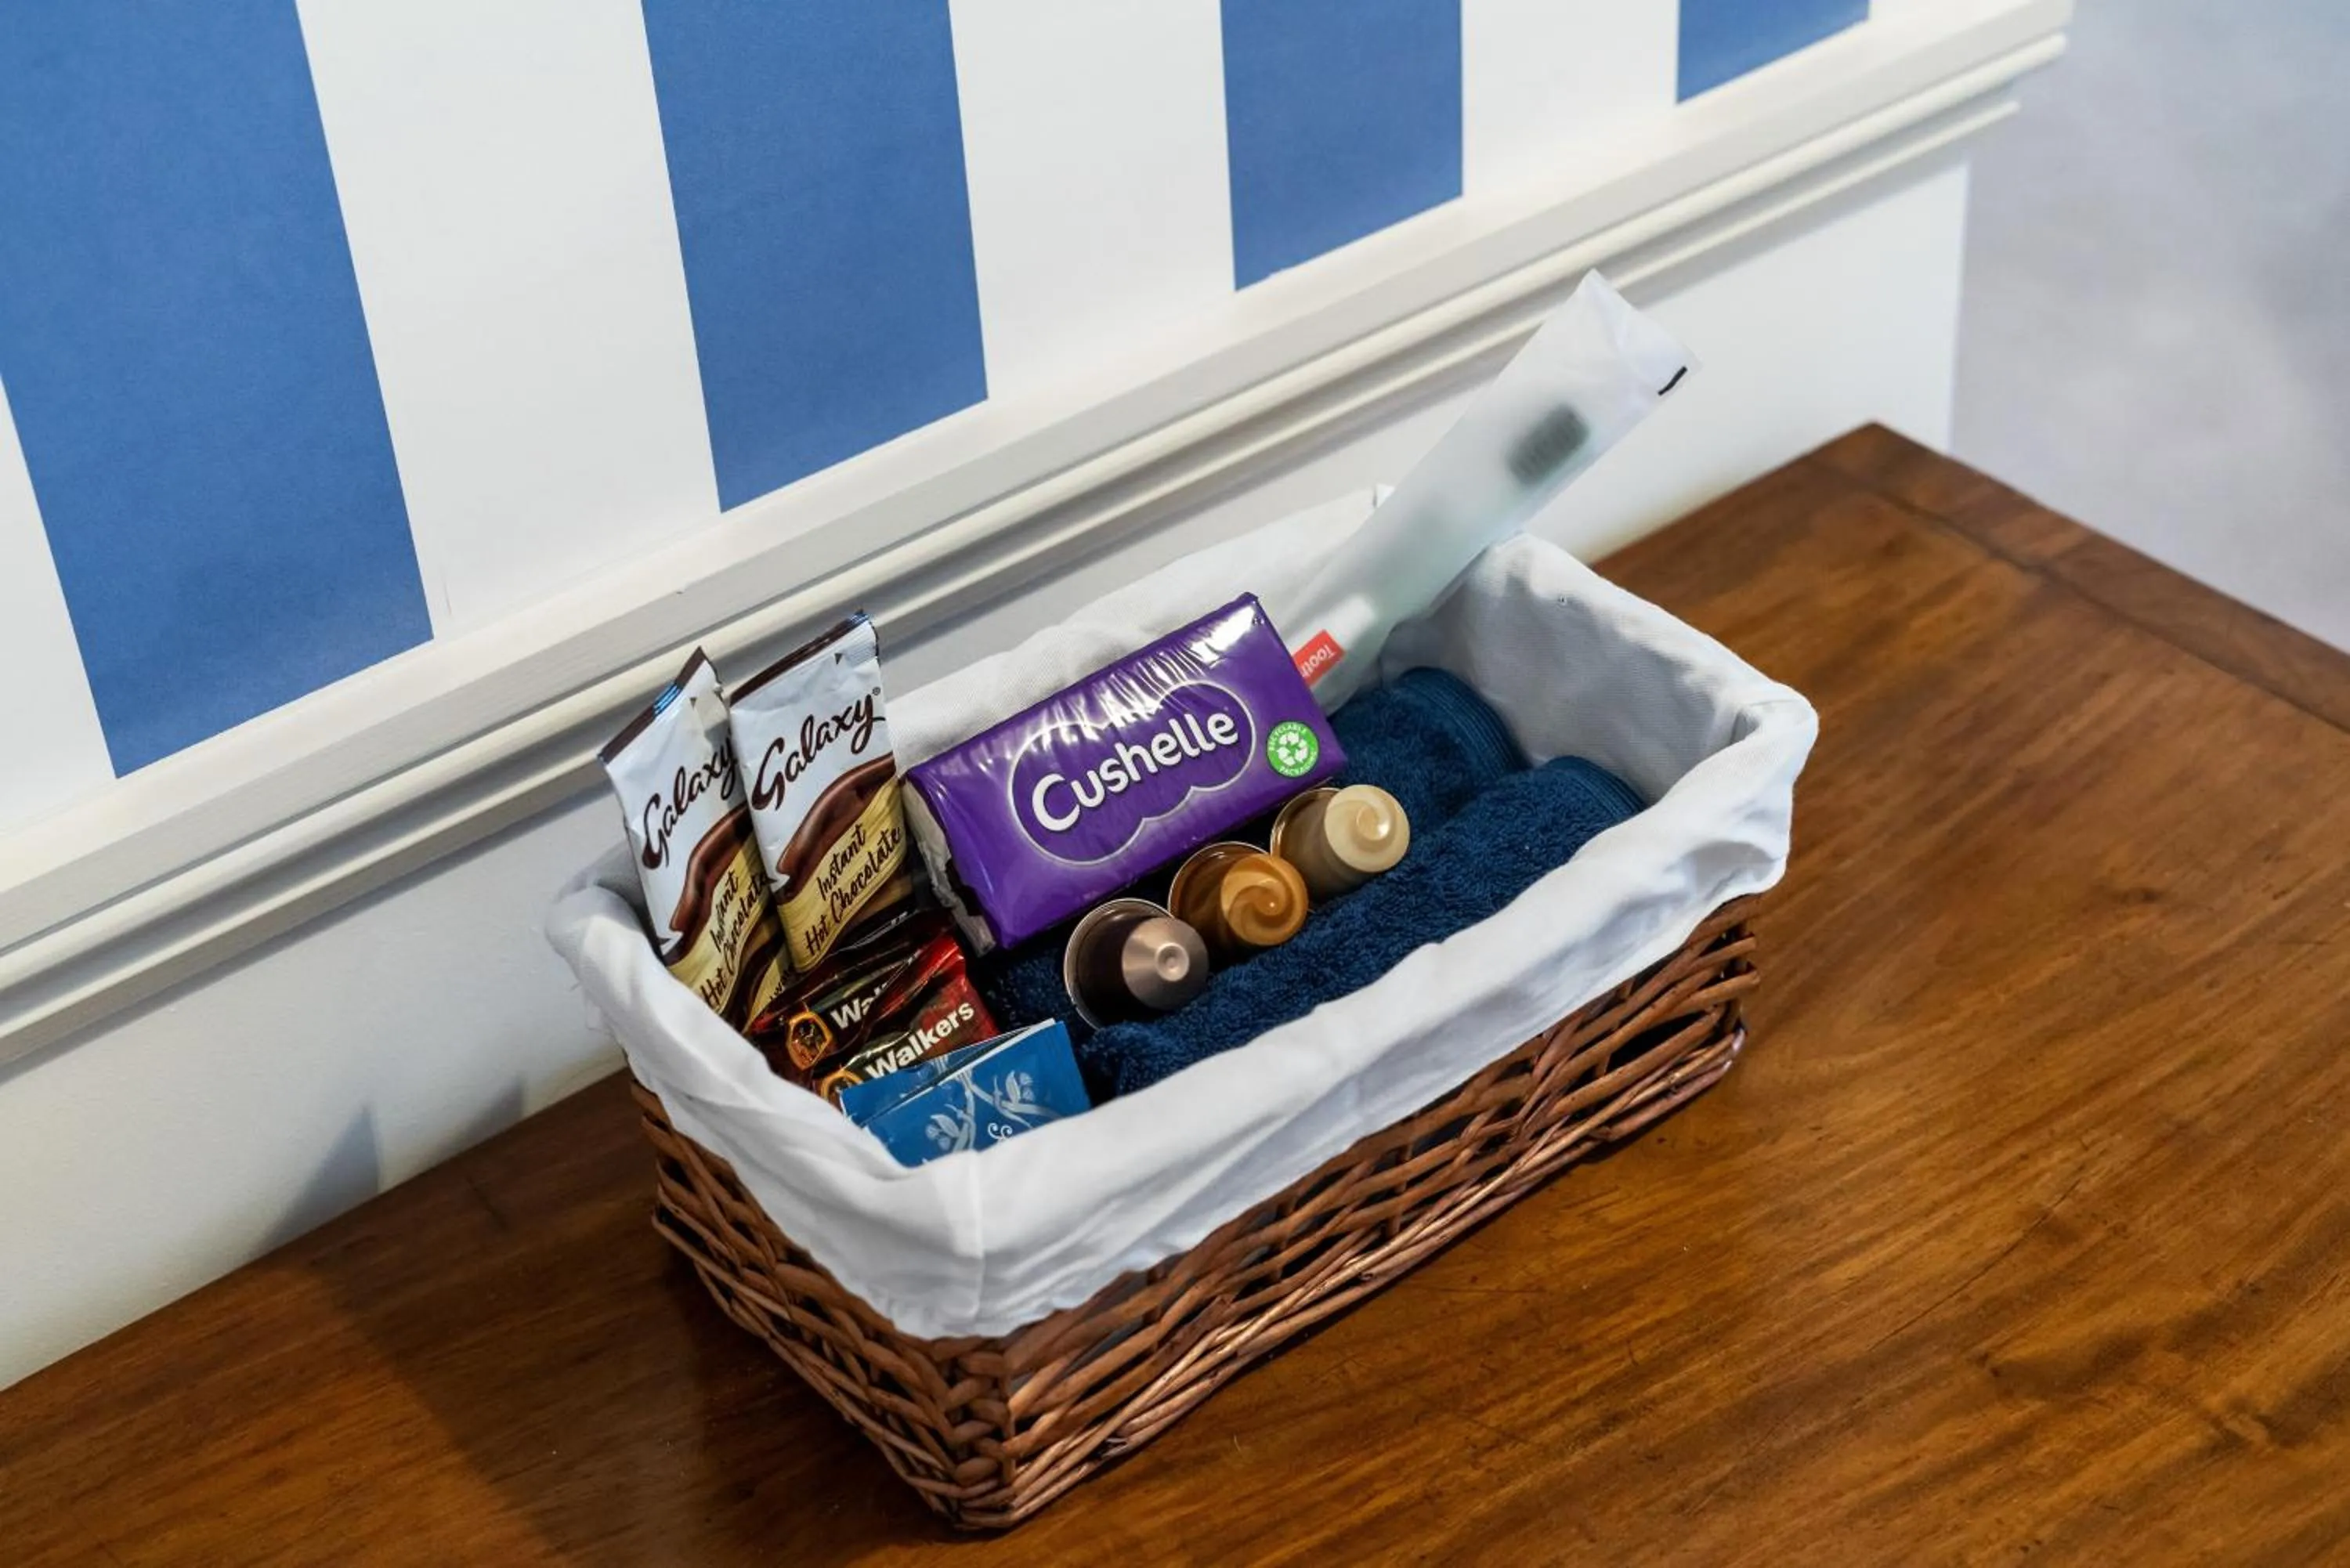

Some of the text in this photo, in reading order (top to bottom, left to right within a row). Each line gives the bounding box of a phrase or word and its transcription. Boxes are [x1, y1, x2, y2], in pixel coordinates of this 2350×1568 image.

[642, 735, 738, 869] Galaxy
[752, 694, 886, 811] Galaxy
[1032, 713, 1238, 831] Cushelle
[804, 827, 900, 956] Hot Chocolate
[816, 824, 866, 901] Instant
[700, 967, 726, 1008] Hot
[865, 1002, 974, 1079] Walkers
